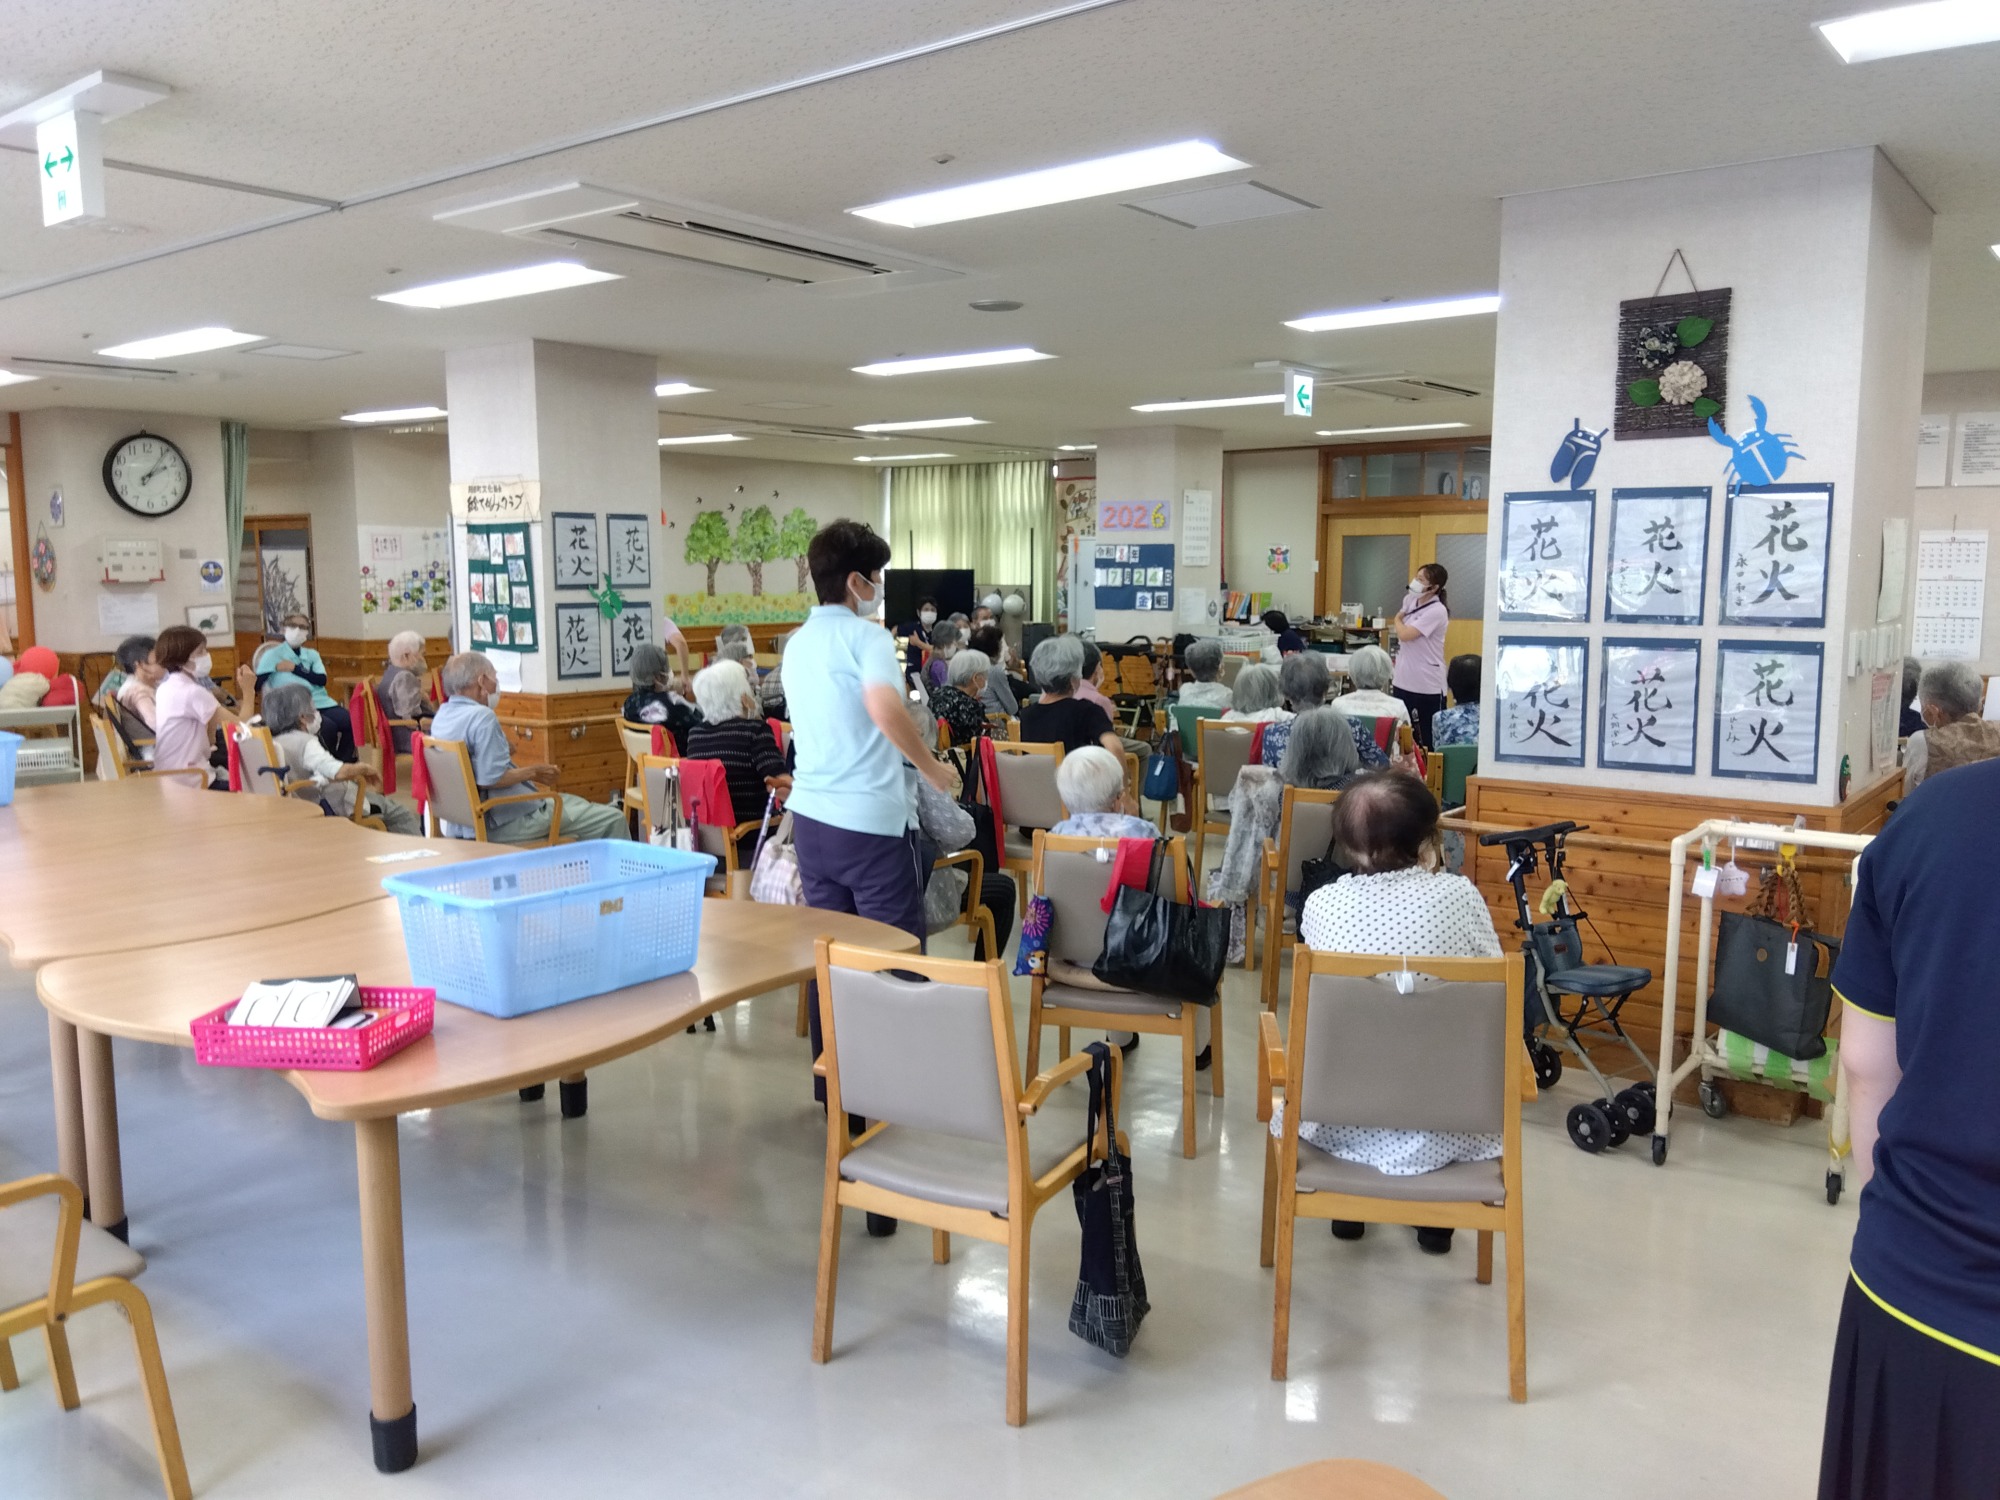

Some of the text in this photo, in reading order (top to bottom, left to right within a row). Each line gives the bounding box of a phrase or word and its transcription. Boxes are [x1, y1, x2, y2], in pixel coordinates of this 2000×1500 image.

[128, 444, 137, 456] 11
[142, 442, 153, 454] 12
[116, 455, 127, 466] 10
[170, 456, 177, 468] 2
[114, 467, 123, 478] 9
[175, 471, 182, 482] 3
[120, 484, 129, 496] 8
[171, 487, 178, 498] 4
[132, 495, 140, 507] 7
[147, 499, 155, 509] 6
[161, 495, 168, 507] 5
[1103, 503, 1166, 529] 2026
[569, 524, 593, 577] 花火
[625, 525, 647, 575] 花火
[1637, 515, 1684, 597] 花火
[1749, 500, 1809, 605] 花火
[1522, 515, 1564, 602] 花火
[565, 612, 589, 672] 花火
[1622, 667, 1673, 748] 花火
[1731, 659, 1794, 763] 花火
